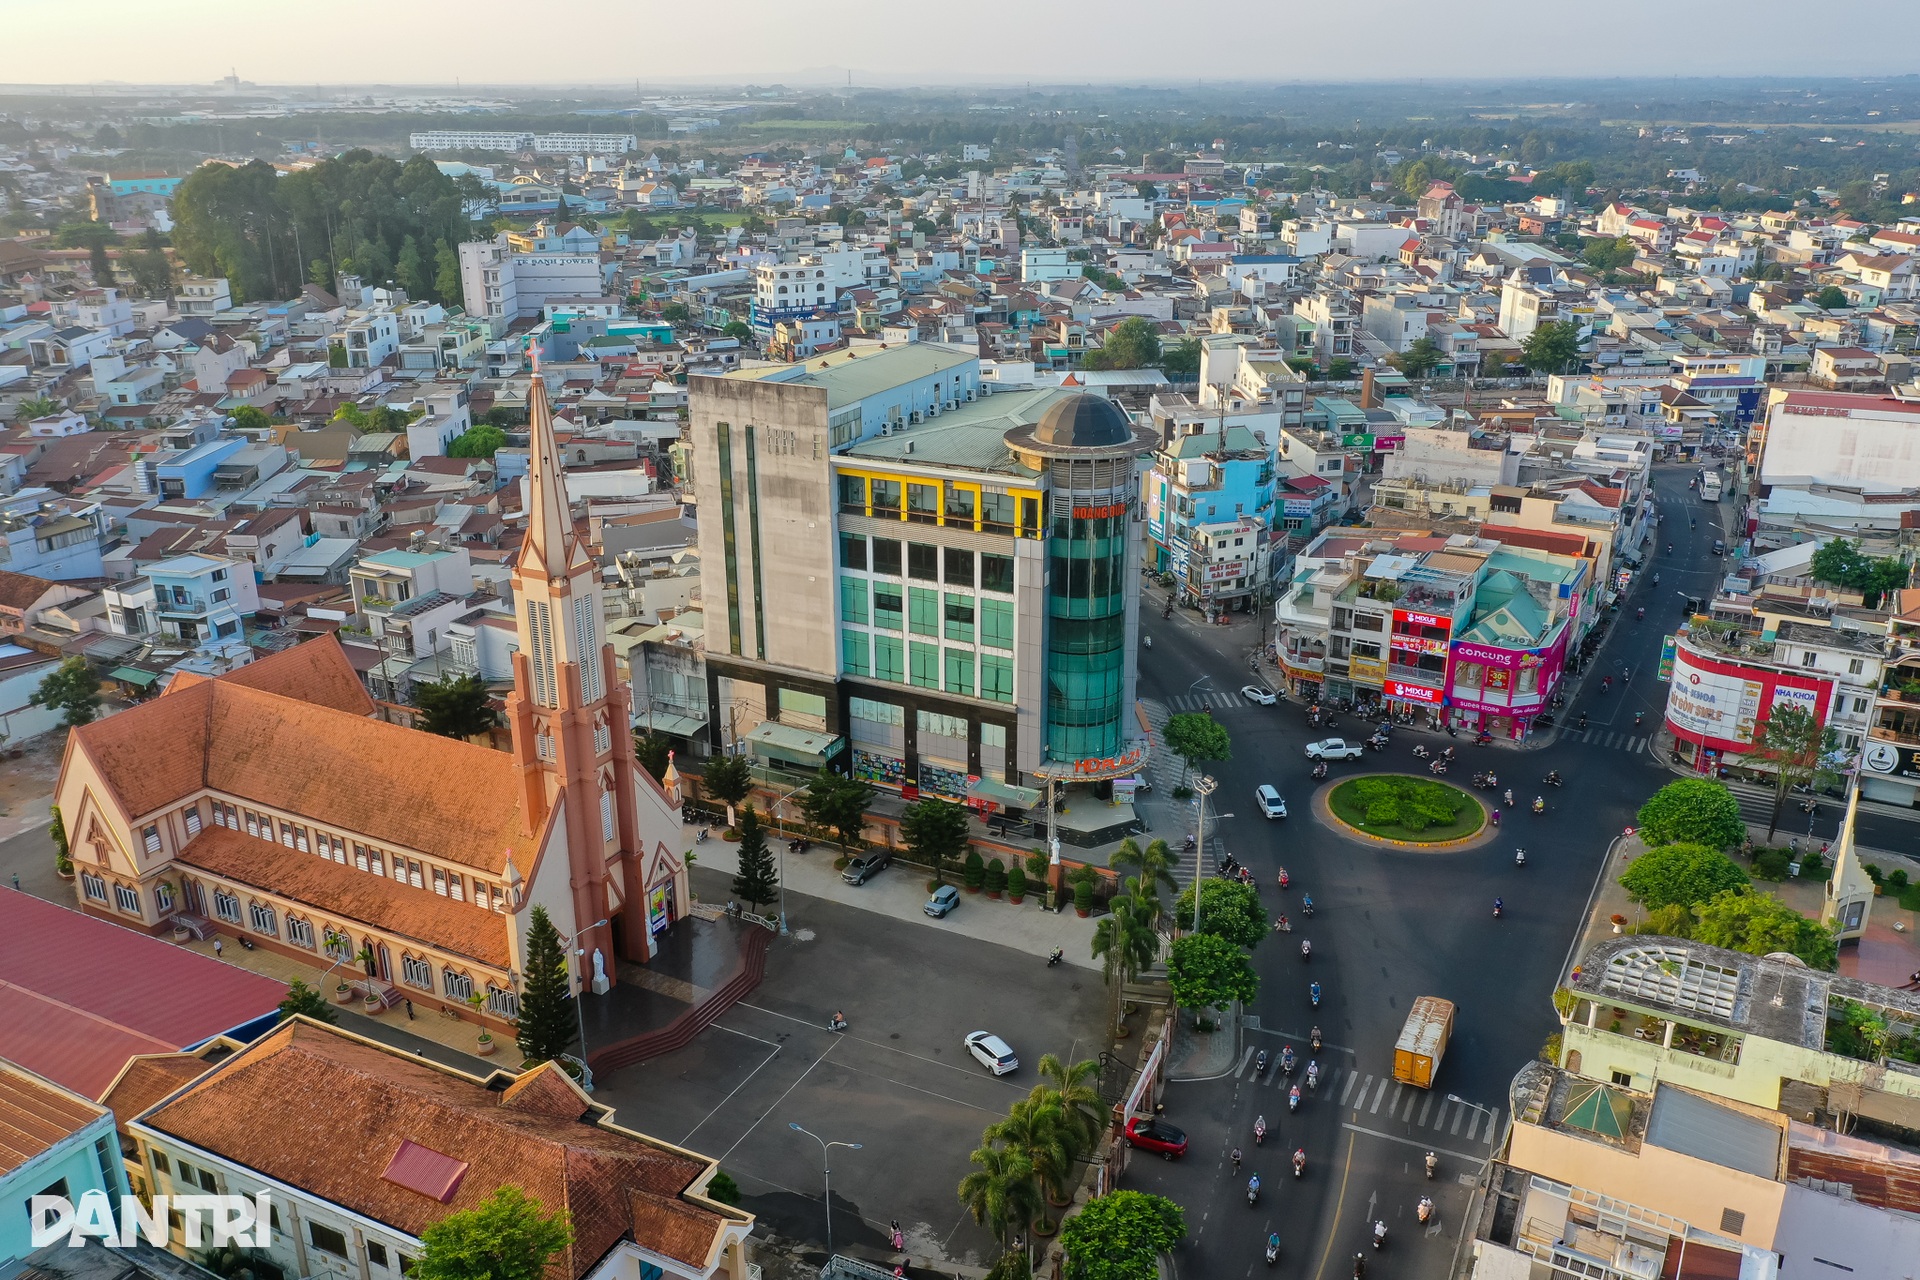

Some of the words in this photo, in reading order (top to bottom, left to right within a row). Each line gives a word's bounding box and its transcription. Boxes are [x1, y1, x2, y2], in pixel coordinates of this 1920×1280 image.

[1225, 562, 1243, 570] KÍNH
[1225, 569, 1240, 577] GÒN
[1414, 614, 1437, 624] MIXUE
[1304, 671, 1322, 681] GÒN
[1405, 686, 1433, 699] MIXUE
[1676, 681, 1688, 695] NHA
[1690, 689, 1716, 704] KHOA
[1775, 688, 1791, 698] NHA
[1792, 692, 1815, 701] KHOA
[1680, 696, 1694, 715] GÒN
[1740, 708, 1755, 716] KHOA
[1075, 758, 1100, 773] HD
